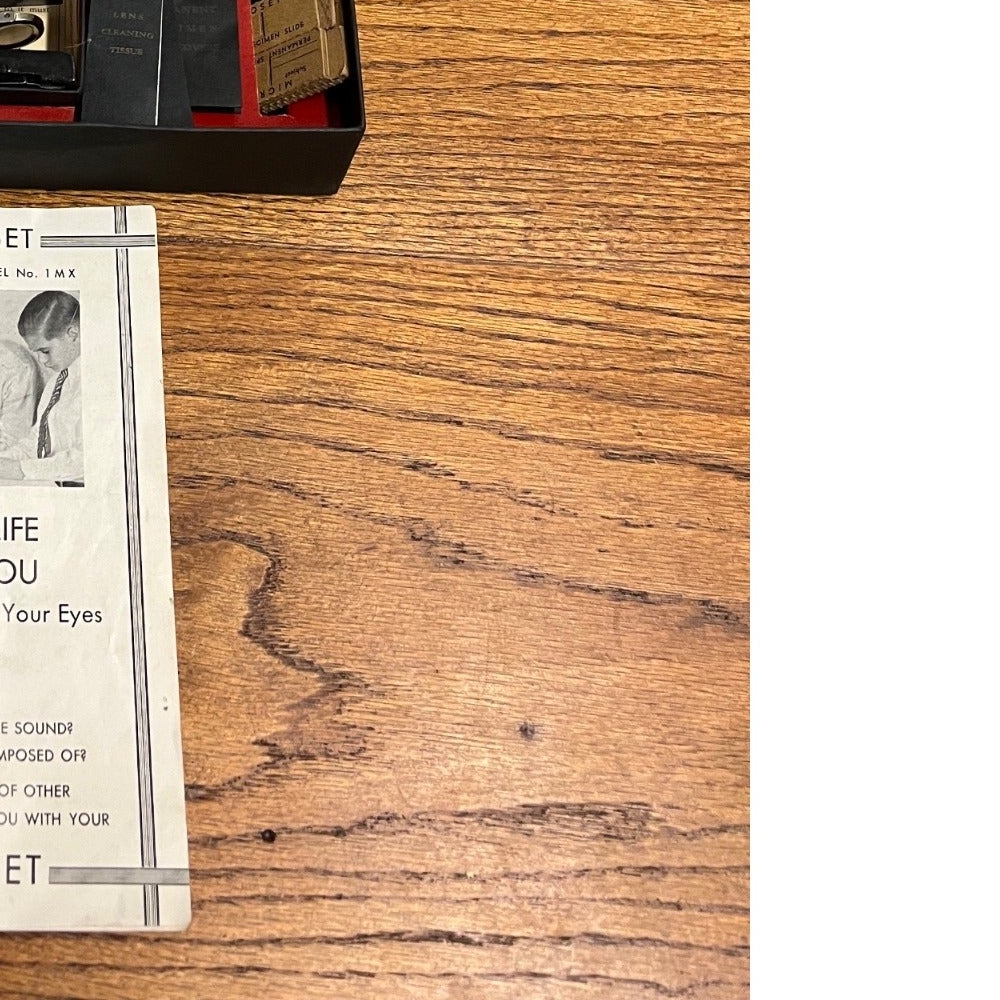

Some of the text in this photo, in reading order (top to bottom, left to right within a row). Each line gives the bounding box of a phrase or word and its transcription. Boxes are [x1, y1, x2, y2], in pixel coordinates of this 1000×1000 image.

[113, 11, 145, 20] LENS
[101, 28, 154, 40] CLEANING
[284, 21, 305, 35] SLIDE
[109, 46, 144, 56] TISSUE
[16, 268, 38, 279] No.
[2, 603, 50, 623] Your
[58, 603, 103, 627] Eyes
[14, 721, 74, 736] SOUND?
[60, 748, 88, 763] OF?
[23, 784, 71, 798] OTHER
[24, 812, 61, 826] WITH
[69, 812, 110, 826] YOUR
